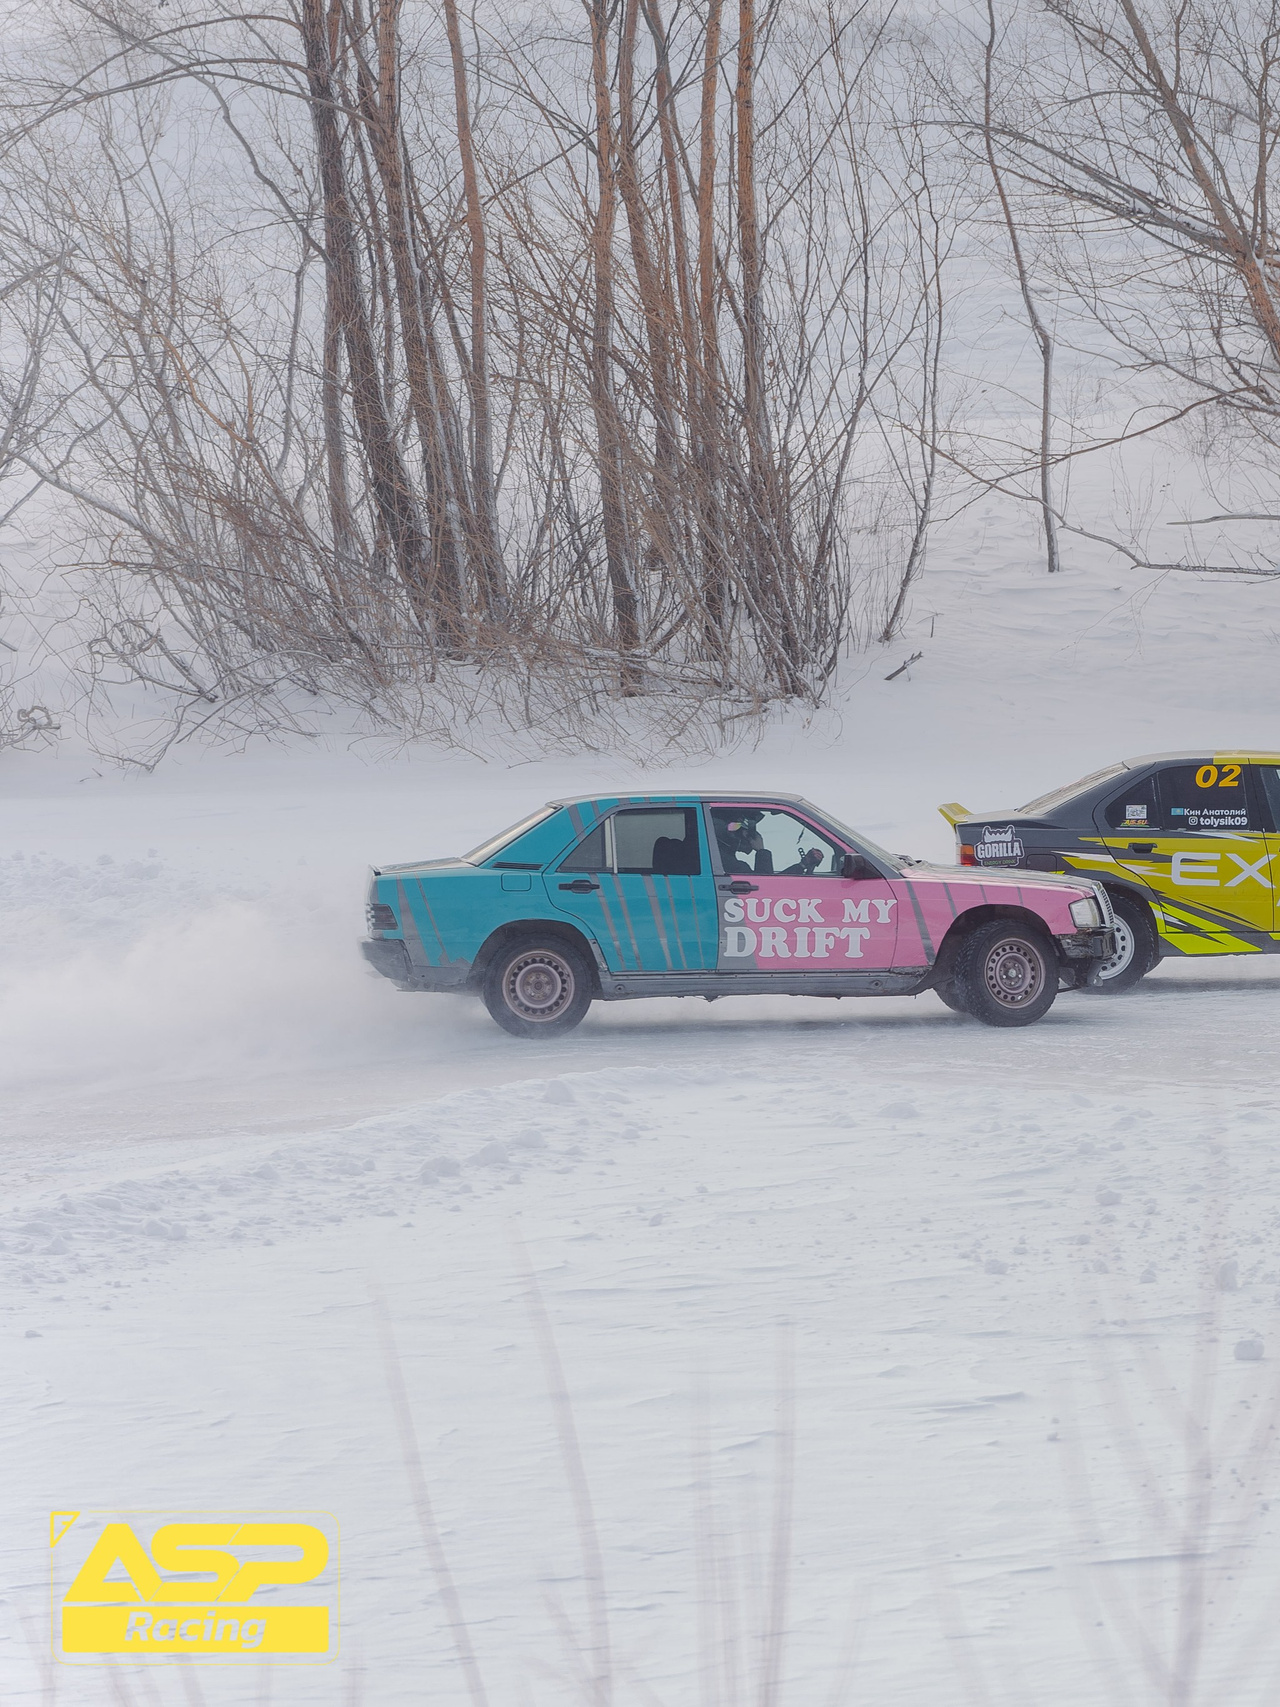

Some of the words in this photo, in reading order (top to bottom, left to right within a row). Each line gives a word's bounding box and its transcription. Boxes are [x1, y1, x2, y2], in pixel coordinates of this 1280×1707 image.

[1195, 765, 1242, 788] 02
[1184, 808, 1201, 816] Кин
[1202, 808, 1246, 816] Анатолий
[1200, 816, 1248, 827] tolysik09
[977, 842, 1022, 859] GORILLA
[723, 898, 825, 923] SUCK
[841, 898, 898, 923] MY
[723, 926, 871, 958] DRIFT
